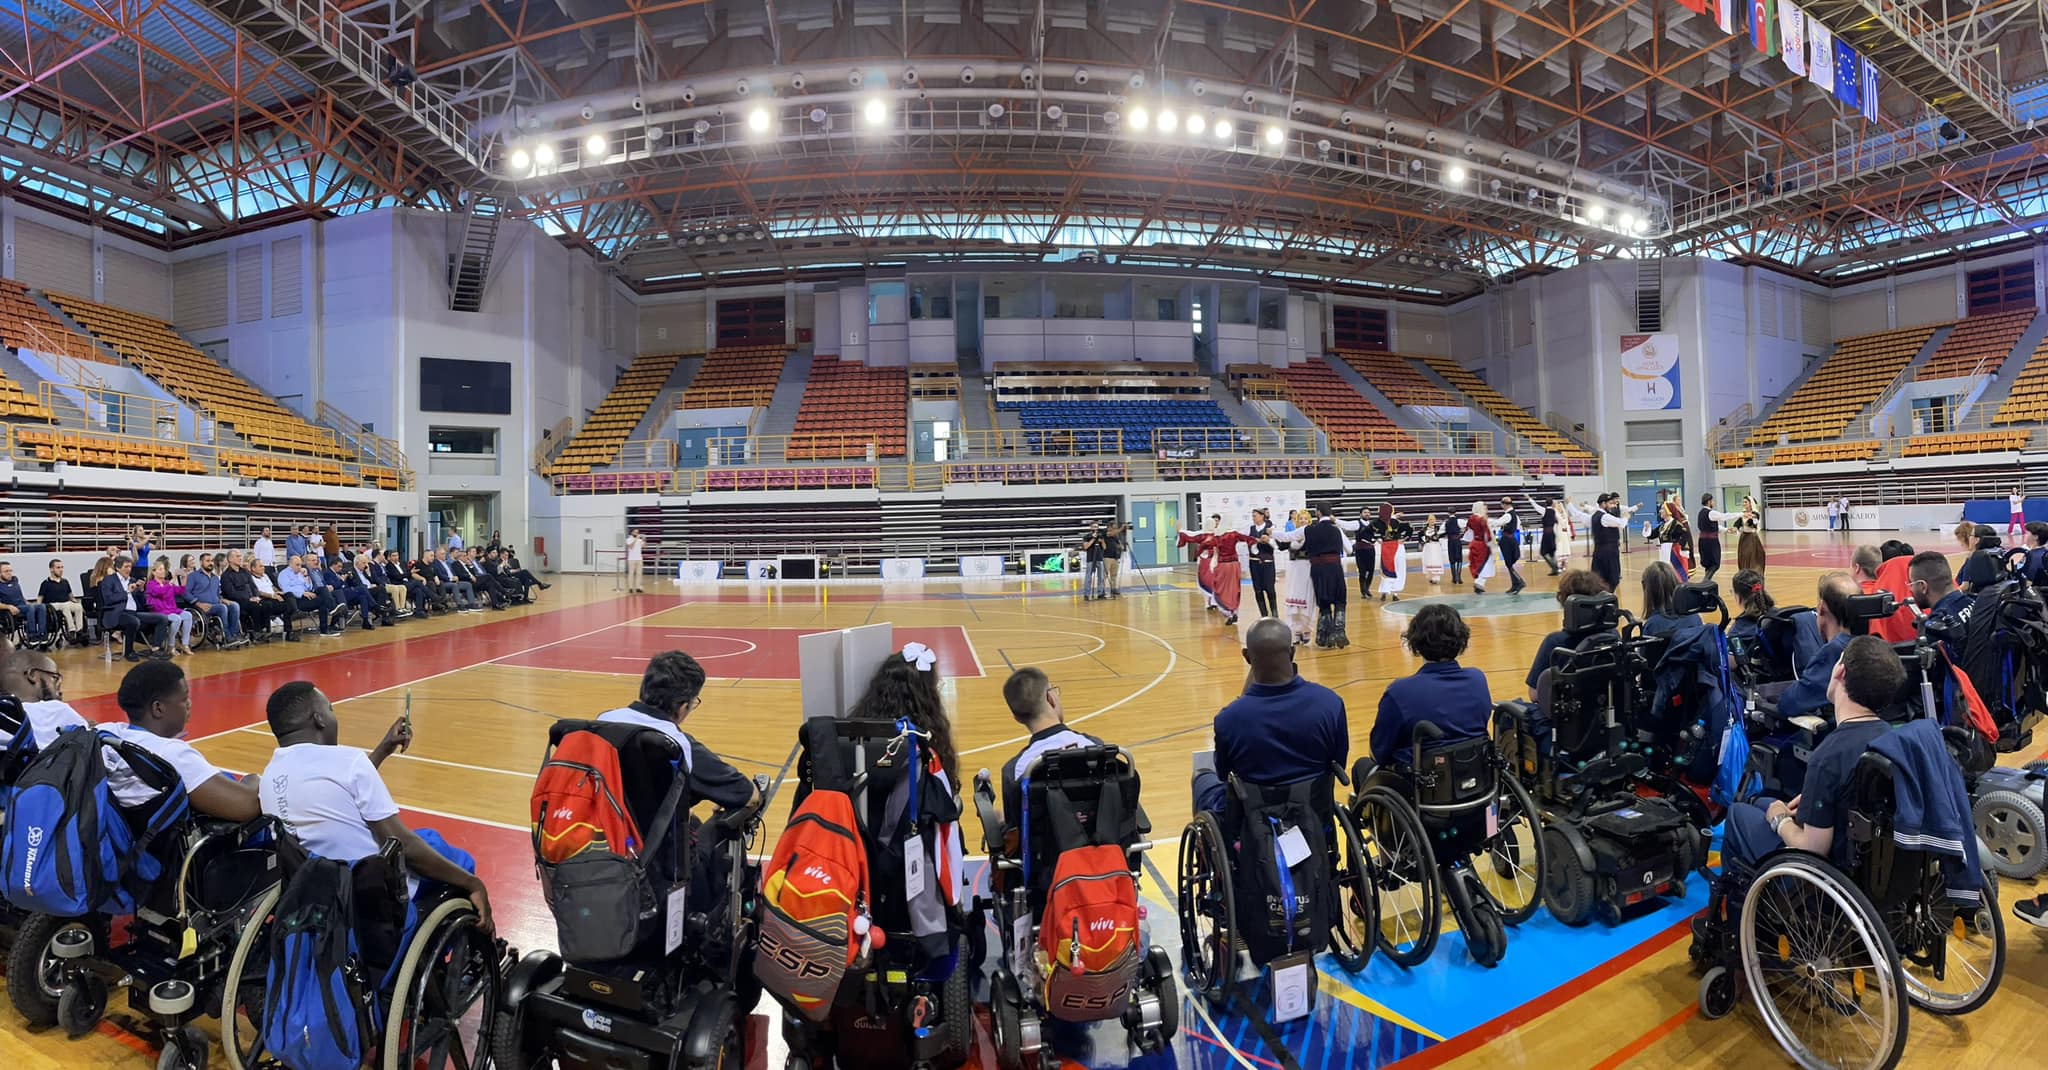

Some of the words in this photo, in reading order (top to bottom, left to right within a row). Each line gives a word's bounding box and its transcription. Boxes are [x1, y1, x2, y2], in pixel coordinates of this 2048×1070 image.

[24, 848, 38, 888] NAMIBIA
[759, 931, 832, 978] ESP
[1062, 985, 1127, 1010] ESP
